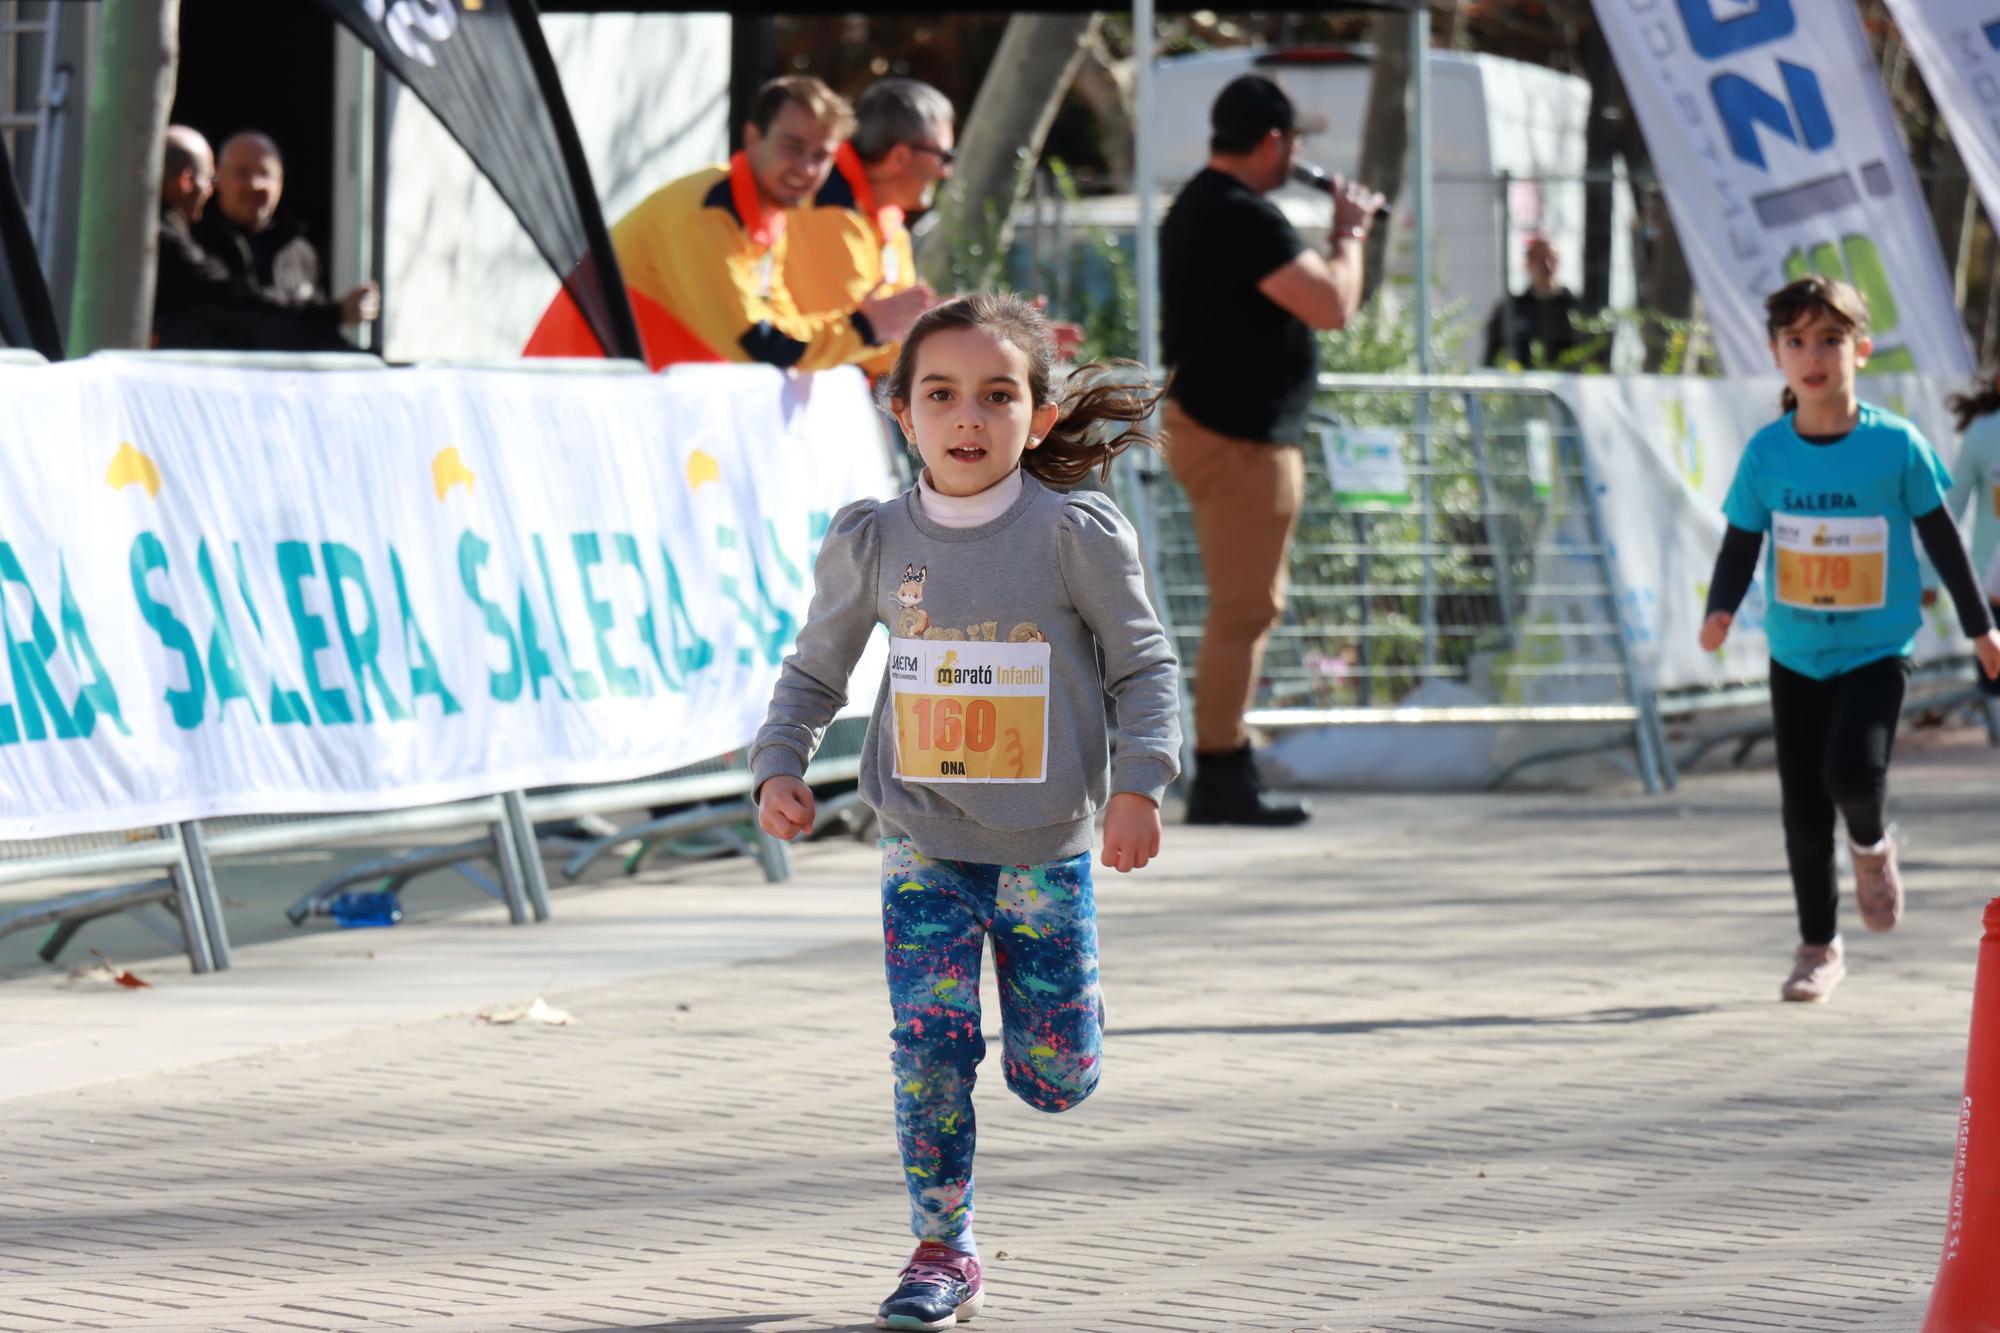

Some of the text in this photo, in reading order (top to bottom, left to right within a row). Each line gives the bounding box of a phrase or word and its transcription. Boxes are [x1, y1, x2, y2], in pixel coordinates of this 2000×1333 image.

[1784, 493, 1857, 511] SALERA
[1797, 555, 1851, 591] 170
[129, 530, 462, 730] SALERA
[937, 665, 992, 685] marató
[912, 698, 997, 752] 160
[941, 761, 966, 776] ONA
